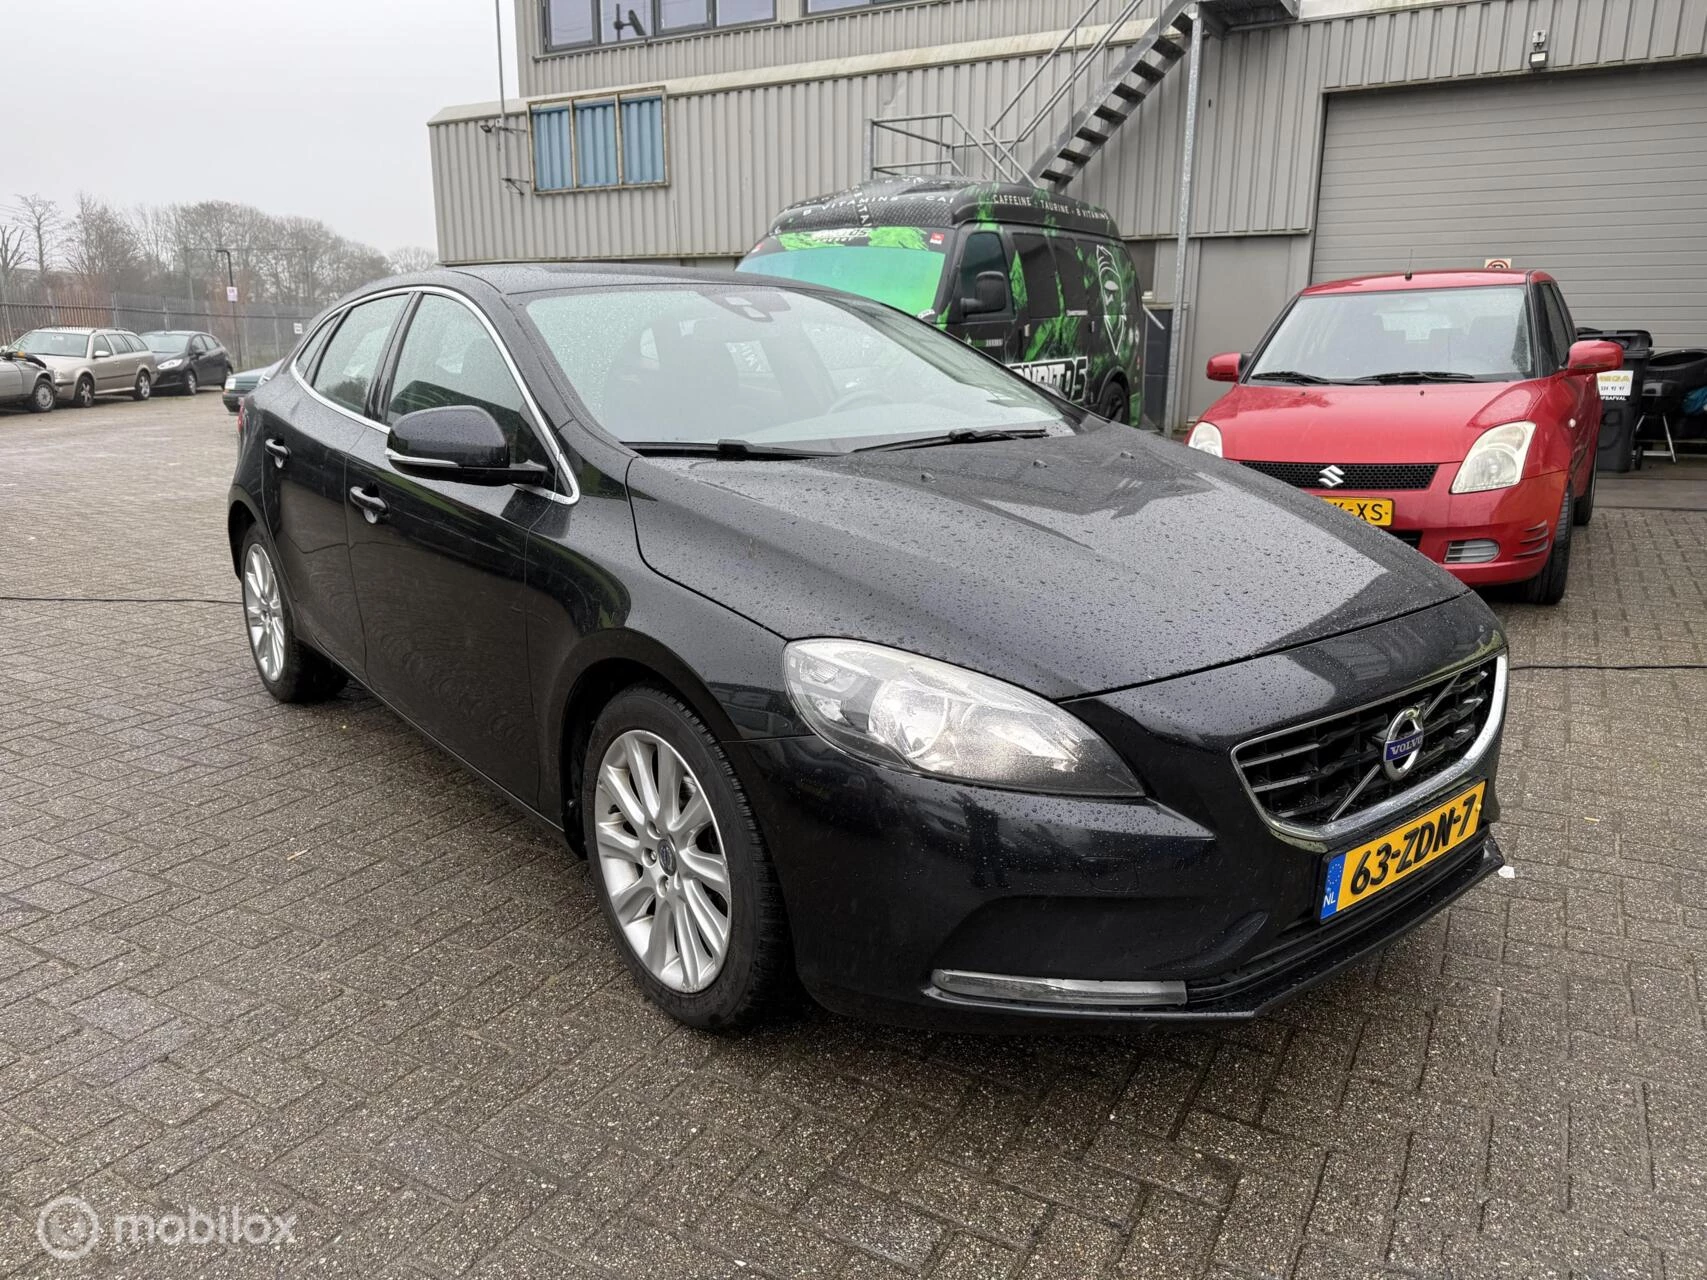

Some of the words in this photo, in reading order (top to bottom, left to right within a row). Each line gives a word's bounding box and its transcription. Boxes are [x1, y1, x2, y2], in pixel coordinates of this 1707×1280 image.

[993, 193, 1032, 207] CAFFEINE
[1040, 199, 1069, 215] TAURINE
[1390, 735, 1423, 755] VOLVO
[1349, 793, 1478, 897] 63-ZDN-7
[1323, 892, 1336, 908] NL
